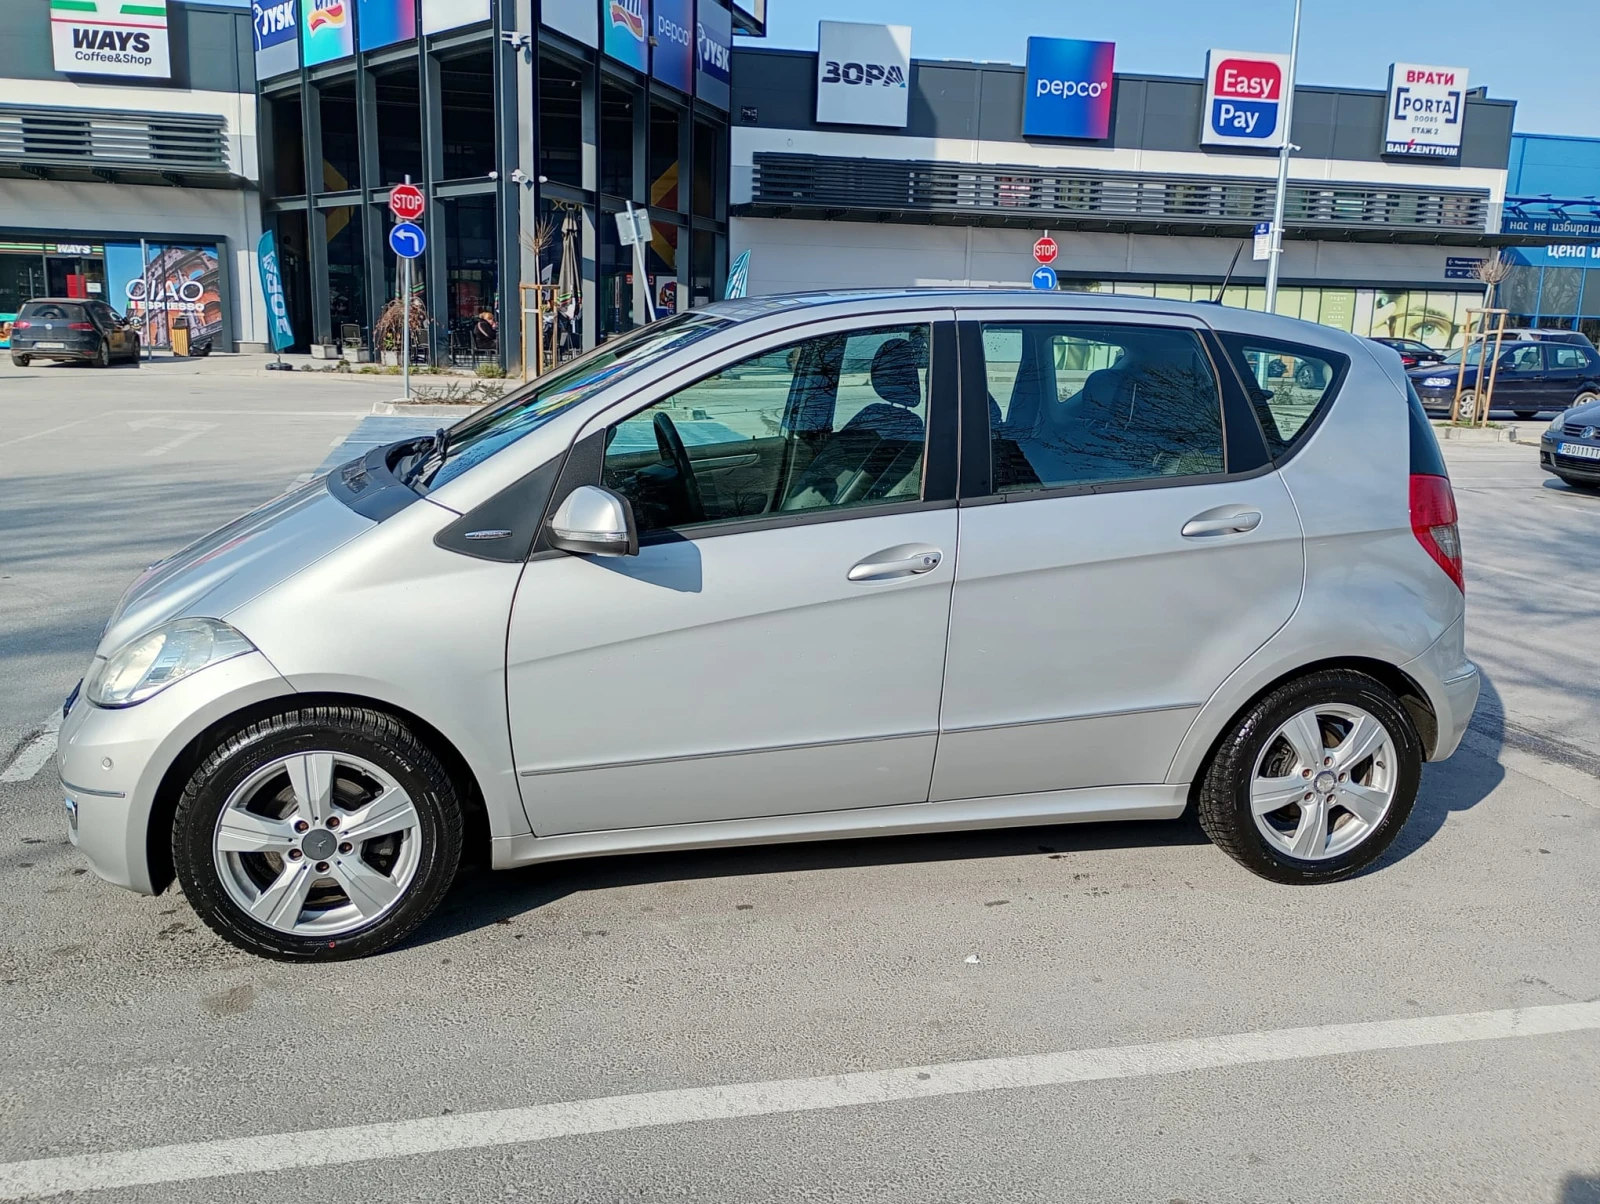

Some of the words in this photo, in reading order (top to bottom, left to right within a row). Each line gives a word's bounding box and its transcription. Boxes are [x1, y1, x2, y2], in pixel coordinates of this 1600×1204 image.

[262, 2, 296, 36] JYSK
[658, 15, 689, 46] pepco
[73, 28, 150, 53] WAYS
[75, 51, 152, 66] Coffee&Shop
[704, 38, 730, 73] JYSK
[821, 61, 906, 88] ЗОРА
[1406, 70, 1455, 86] ВРАТИ
[1223, 69, 1274, 98] Easy
[1403, 97, 1452, 114] PORTA
[1219, 104, 1259, 133] Pay
[1414, 115, 1438, 123] DOORS
[393, 194, 422, 210] STOP
[1510, 221, 1529, 231] нас
[1534, 223, 1547, 231] не
[57, 244, 91, 254] WAYS
[1035, 245, 1056, 256] STOP
[1548, 245, 1586, 259] цена
[125, 279, 204, 302] CIAO
